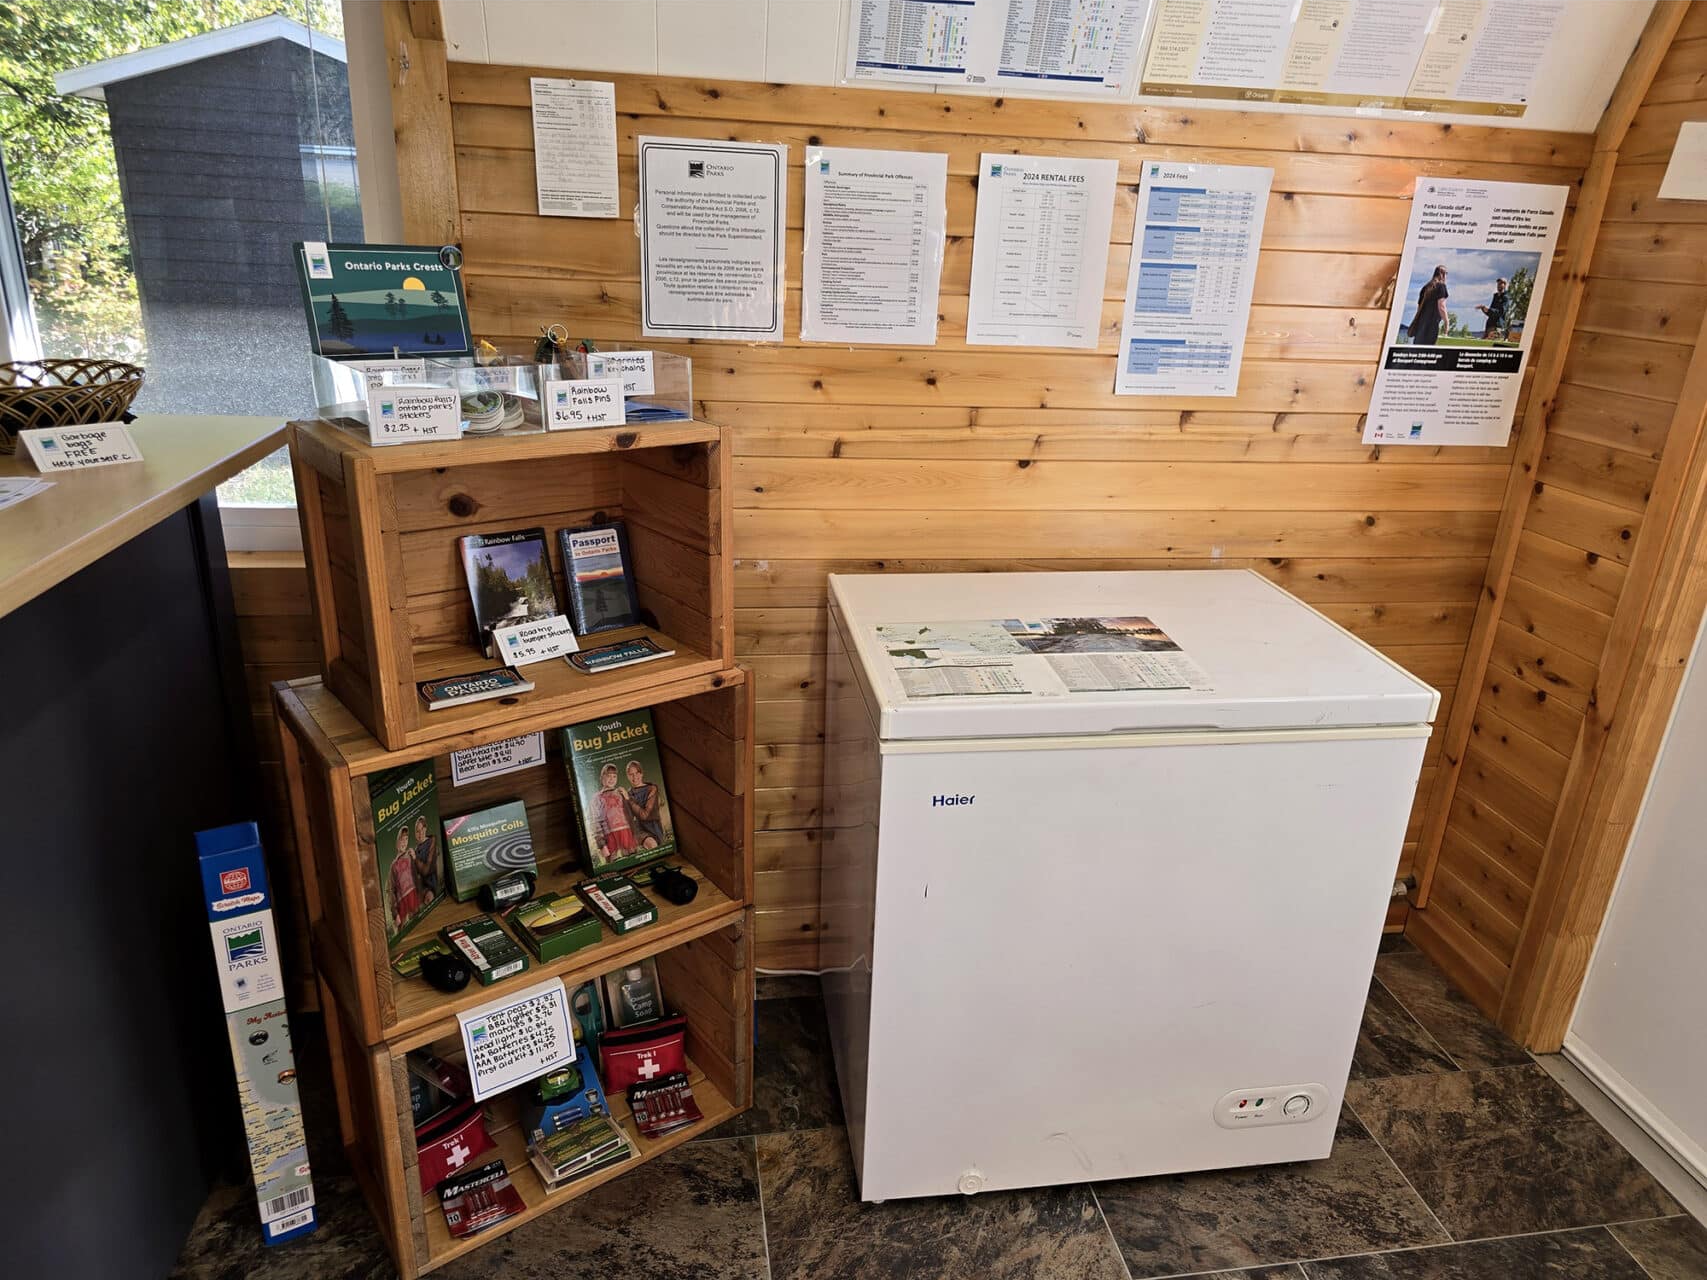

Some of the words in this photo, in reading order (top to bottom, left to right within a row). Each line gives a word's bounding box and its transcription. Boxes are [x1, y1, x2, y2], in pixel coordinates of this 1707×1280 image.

[344, 261, 382, 271] Ontario
[385, 262, 411, 271] Parks
[413, 262, 443, 271] Crests
[571, 385, 608, 394] Rainbow
[572, 397, 593, 405] Falls
[555, 411, 583, 421] $6.95
[384, 423, 410, 432] $2.25
[422, 426, 438, 434] HST
[60, 431, 107, 441] Garbage
[66, 440, 93, 450] bags
[64, 448, 98, 458] FREE
[52, 459, 74, 468] Help
[572, 535, 616, 548] Passport
[513, 647, 536, 658] $5.95
[624, 647, 649, 656] FALLS
[444, 678, 498, 692] ONTARIO
[597, 720, 622, 732] Youth
[573, 737, 602, 752] Bug
[606, 723, 649, 744] Jacket
[396, 778, 414, 794] Youth
[378, 800, 399, 823] Bug
[402, 773, 432, 805] Jacket
[932, 794, 975, 807] Haier
[452, 828, 499, 846] Mosquito
[501, 820, 524, 832] Coils
[222, 920, 263, 934] ONTARIO
[229, 956, 268, 972] PARKS
[632, 999, 652, 1011] Camp
[486, 1012, 505, 1023] Tent
[507, 1004, 527, 1016] pegs
[635, 1008, 653, 1018] Soap
[488, 1021, 506, 1031] BBQ
[475, 1052, 486, 1061] AA
[487, 1036, 528, 1056] Batteries
[530, 1026, 554, 1040] $4.25
[476, 1059, 493, 1069] AAA
[494, 1044, 531, 1063] Batteries
[478, 1067, 497, 1077] First
[499, 1059, 514, 1069] aid
[529, 1041, 555, 1056] $11.95
[546, 1051, 558, 1061] HST
[637, 1052, 652, 1060] Trek
[442, 1137, 459, 1150] Trek
[443, 1170, 505, 1199] MASTERCELL
[449, 1214, 459, 1222] 10
